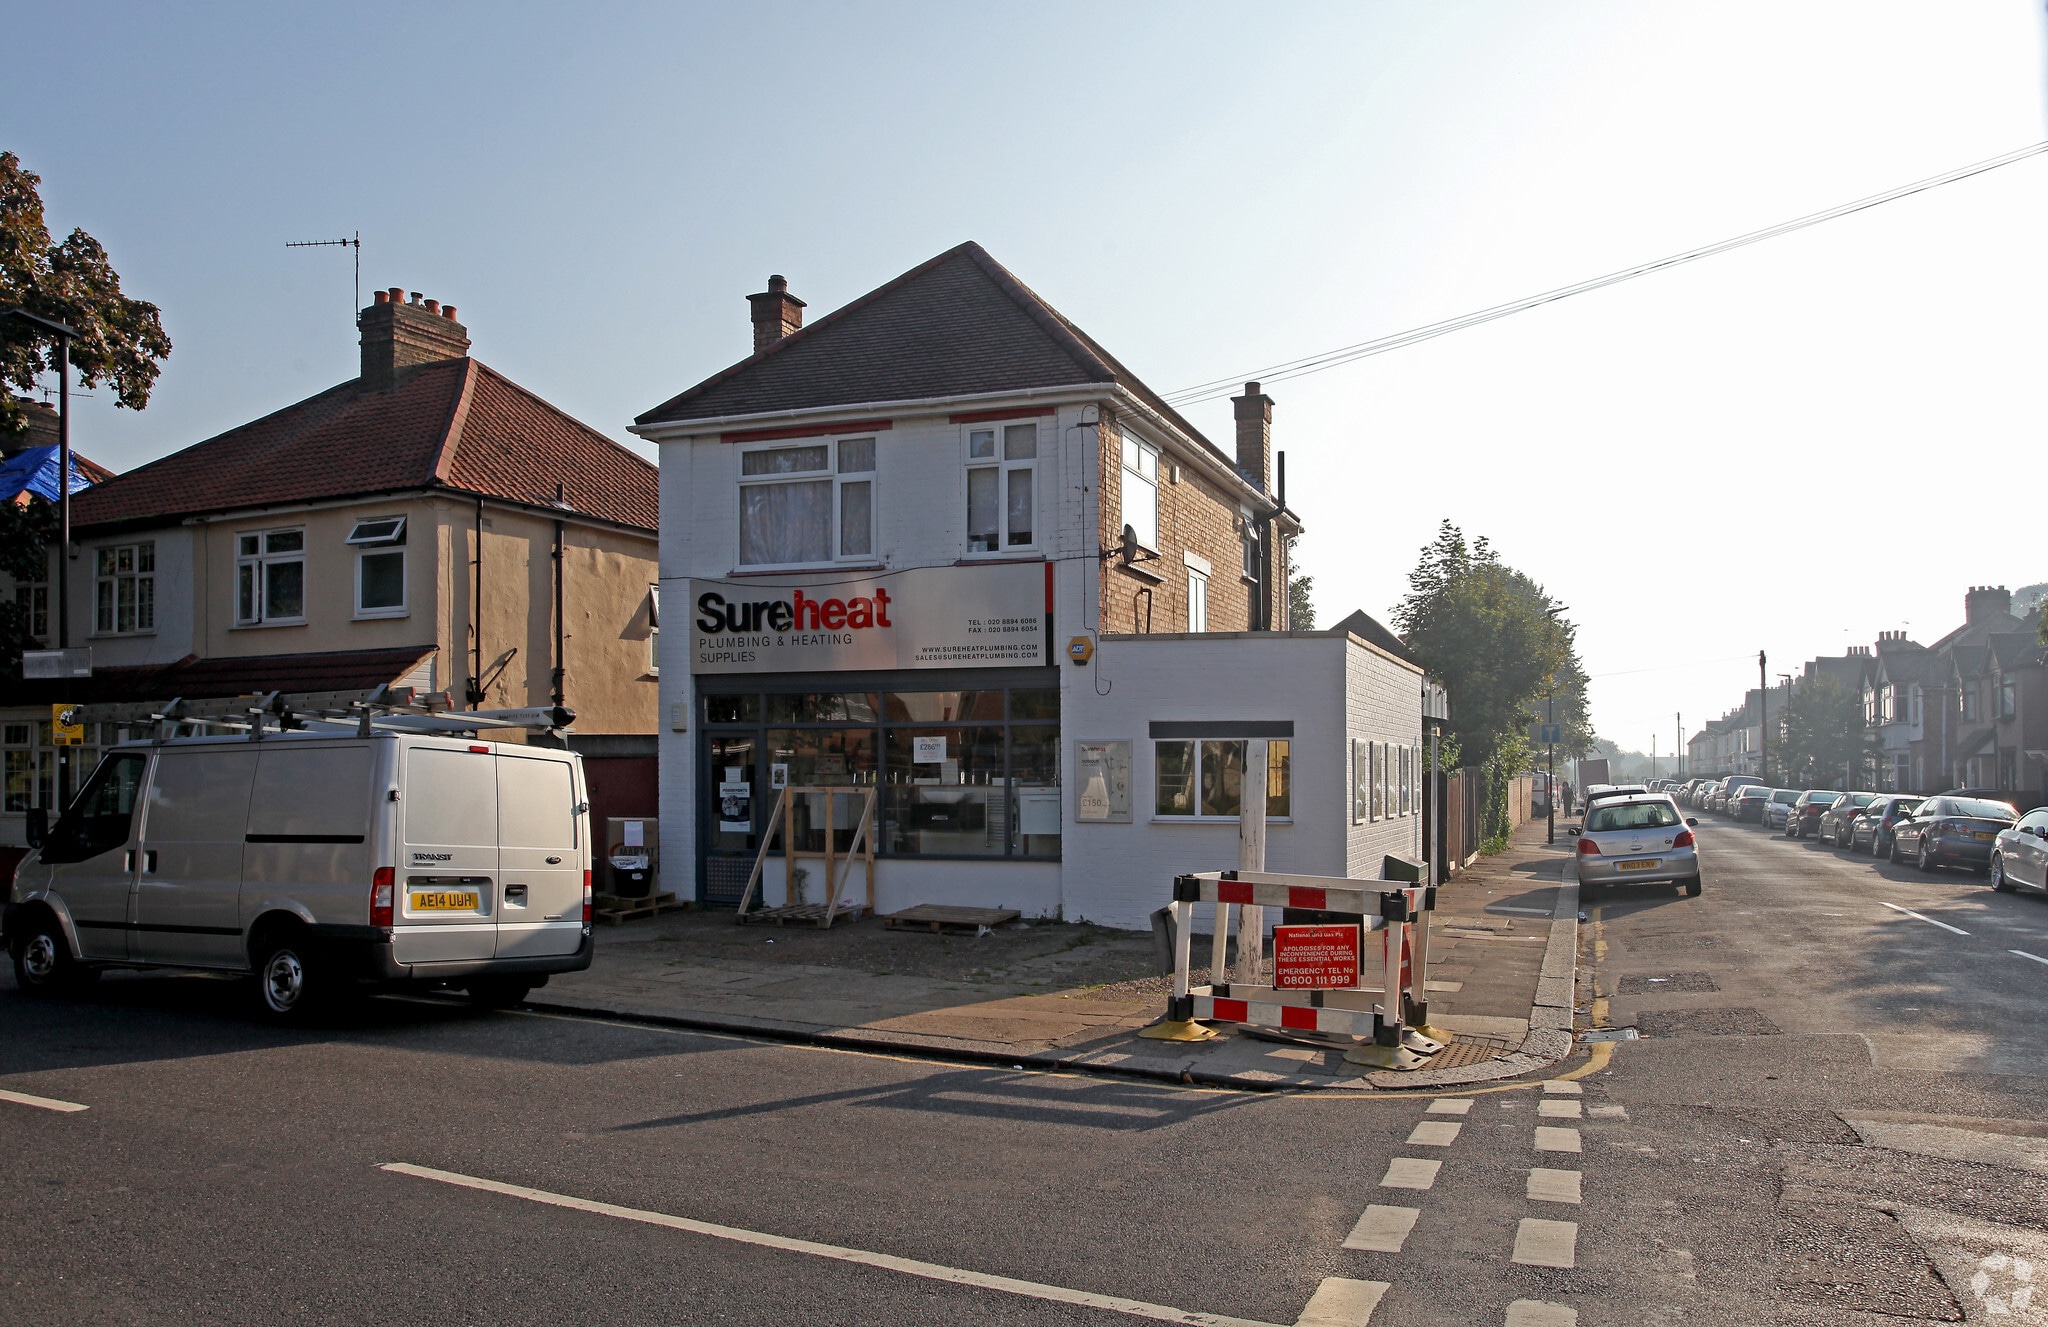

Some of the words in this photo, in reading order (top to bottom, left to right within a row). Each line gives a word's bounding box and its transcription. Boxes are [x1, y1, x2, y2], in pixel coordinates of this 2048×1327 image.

[696, 587, 892, 634] Sureheat
[699, 636, 771, 649] PLUMBING
[777, 636, 785, 647] &
[791, 633, 853, 647] HEATING
[922, 644, 1038, 653] WWW.SUREHEATPLUMBING.COM
[700, 651, 756, 664] SUPPLIES
[915, 652, 1038, 662] SALES@SUREHEATPLUMBING.COM
[1082, 798, 1102, 807] £150
[412, 853, 453, 861] TRANSIT
[419, 892, 446, 907] AE14
[449, 892, 472, 907] UUH
[1278, 967, 1325, 975] EMERGENCY
[1283, 976, 1313, 985] 0800
[1316, 975, 1328, 984] 111
[1330, 975, 1350, 984] 999
